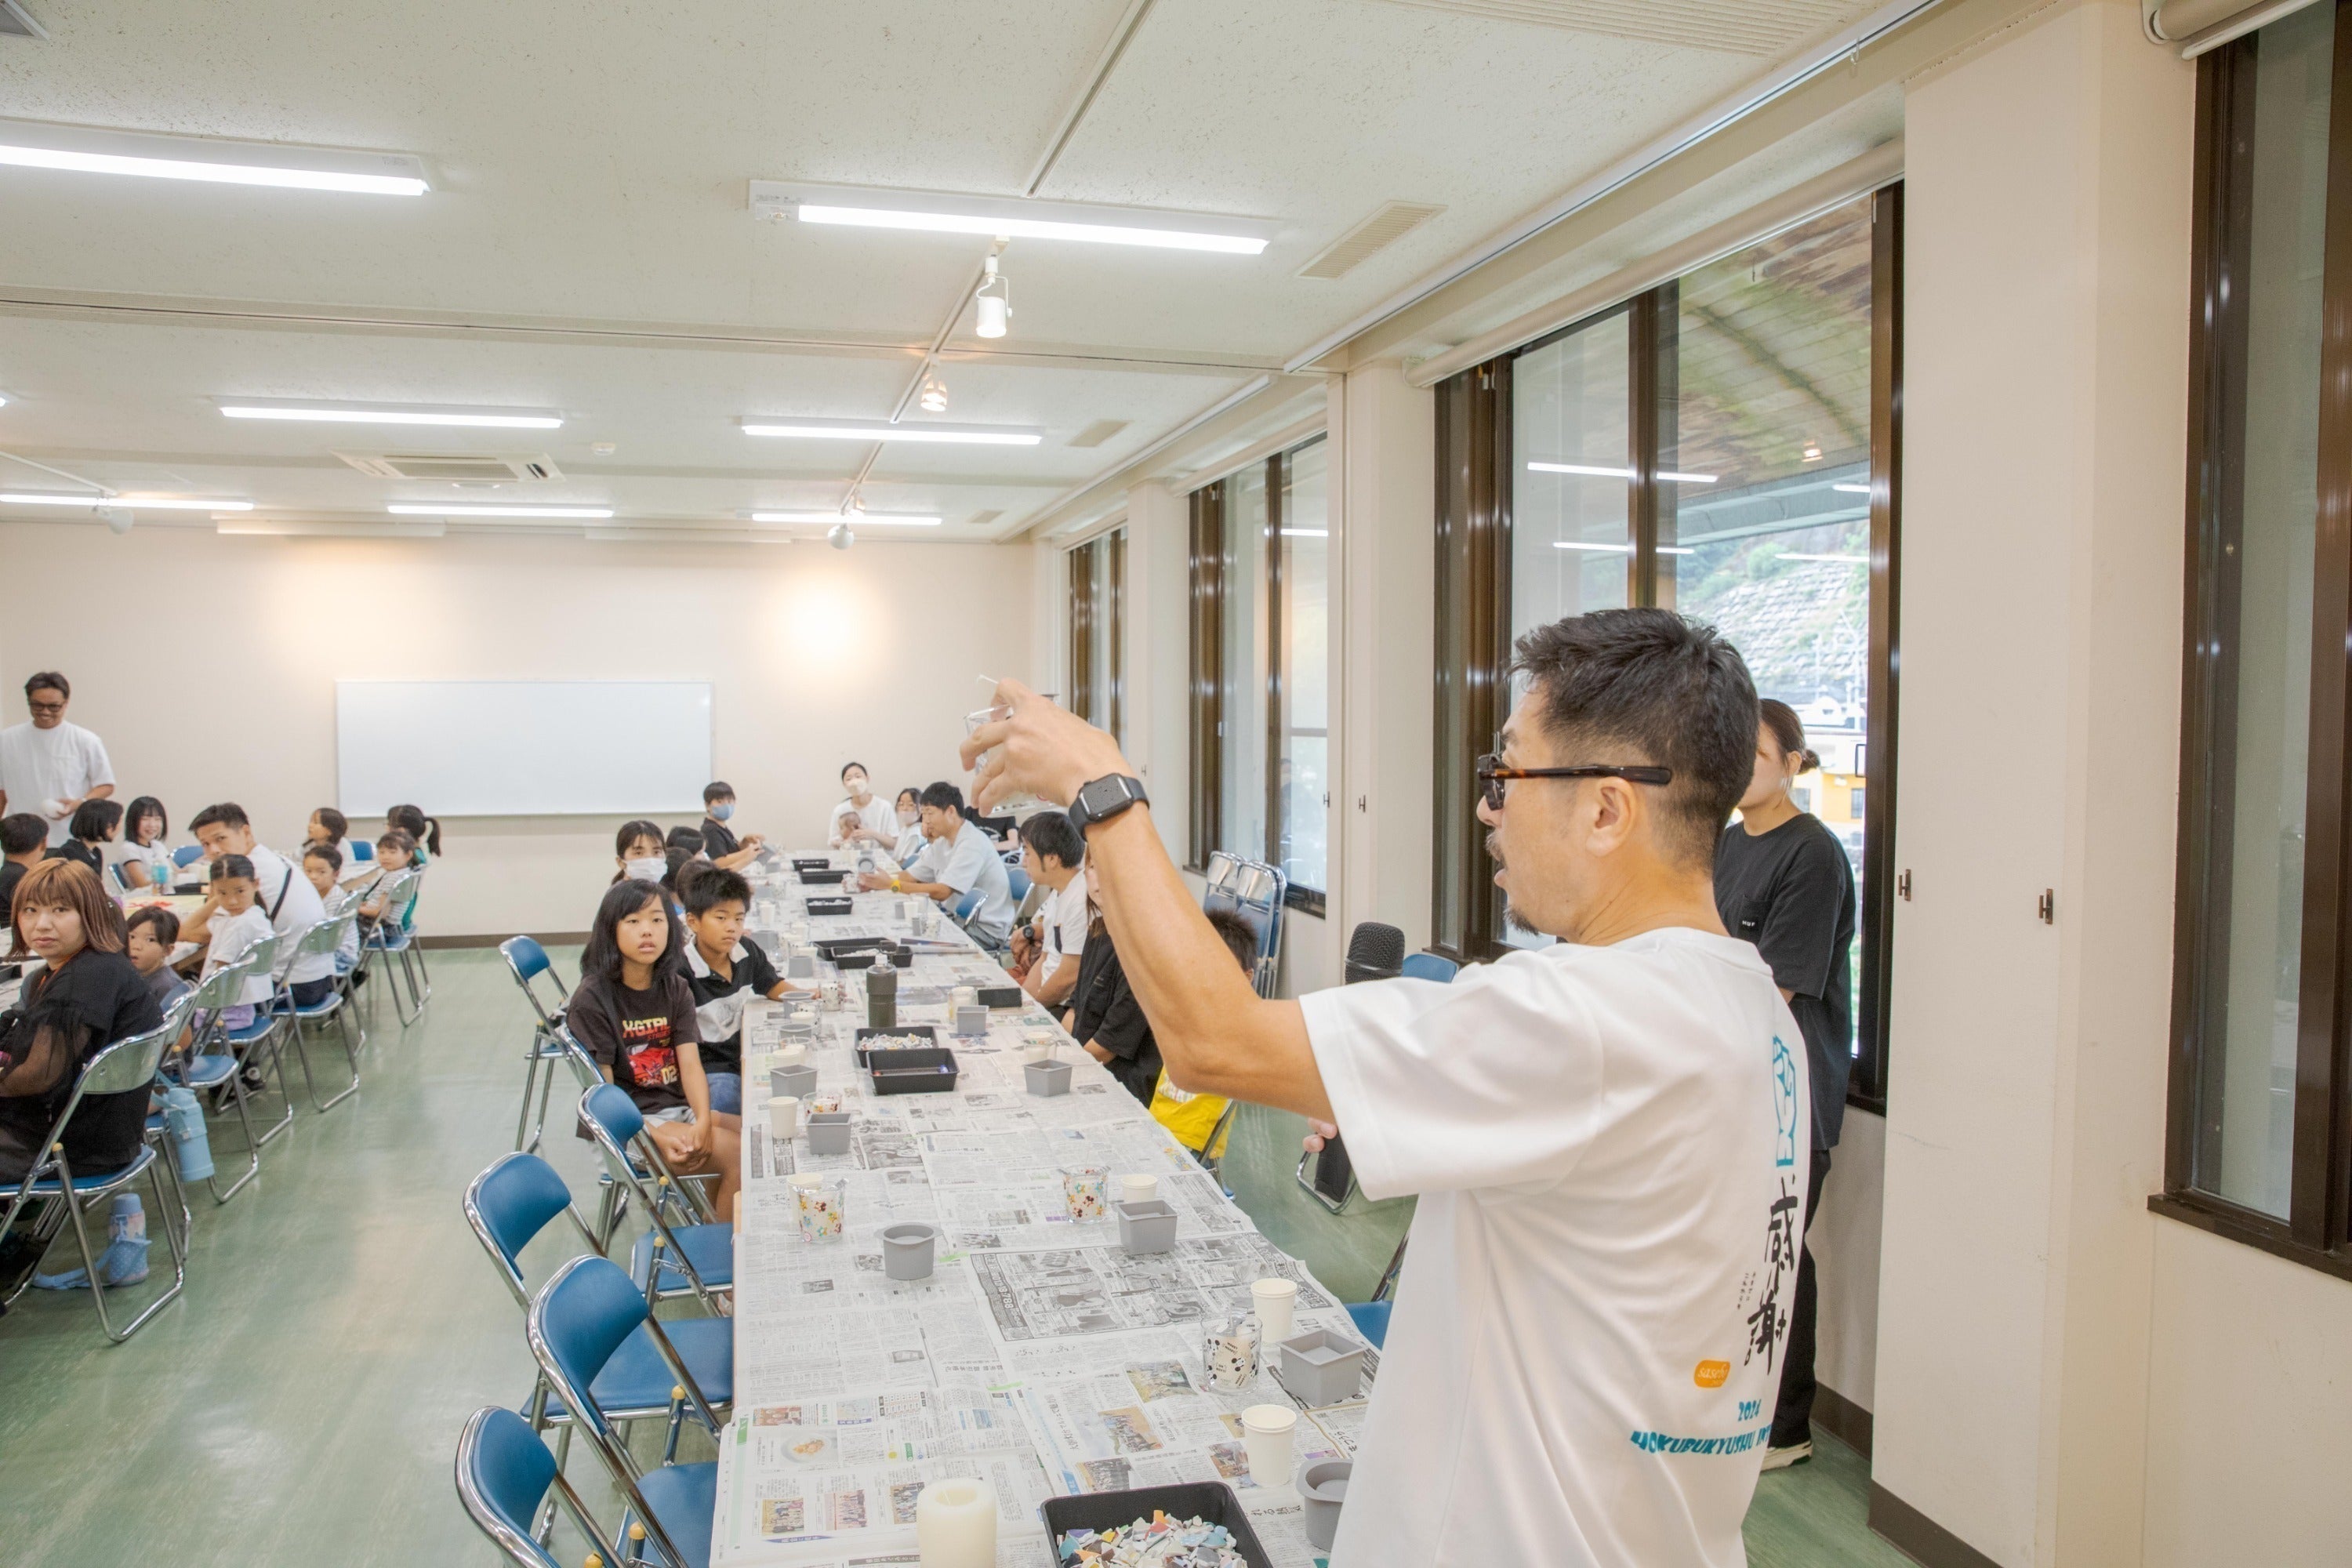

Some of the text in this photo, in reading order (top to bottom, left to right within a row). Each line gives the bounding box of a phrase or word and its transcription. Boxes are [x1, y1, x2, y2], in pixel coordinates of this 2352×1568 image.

[661, 1065, 677, 1085] 02
[1744, 1174, 1798, 1375] 感謝
[1737, 1399, 1761, 1421] 2024
